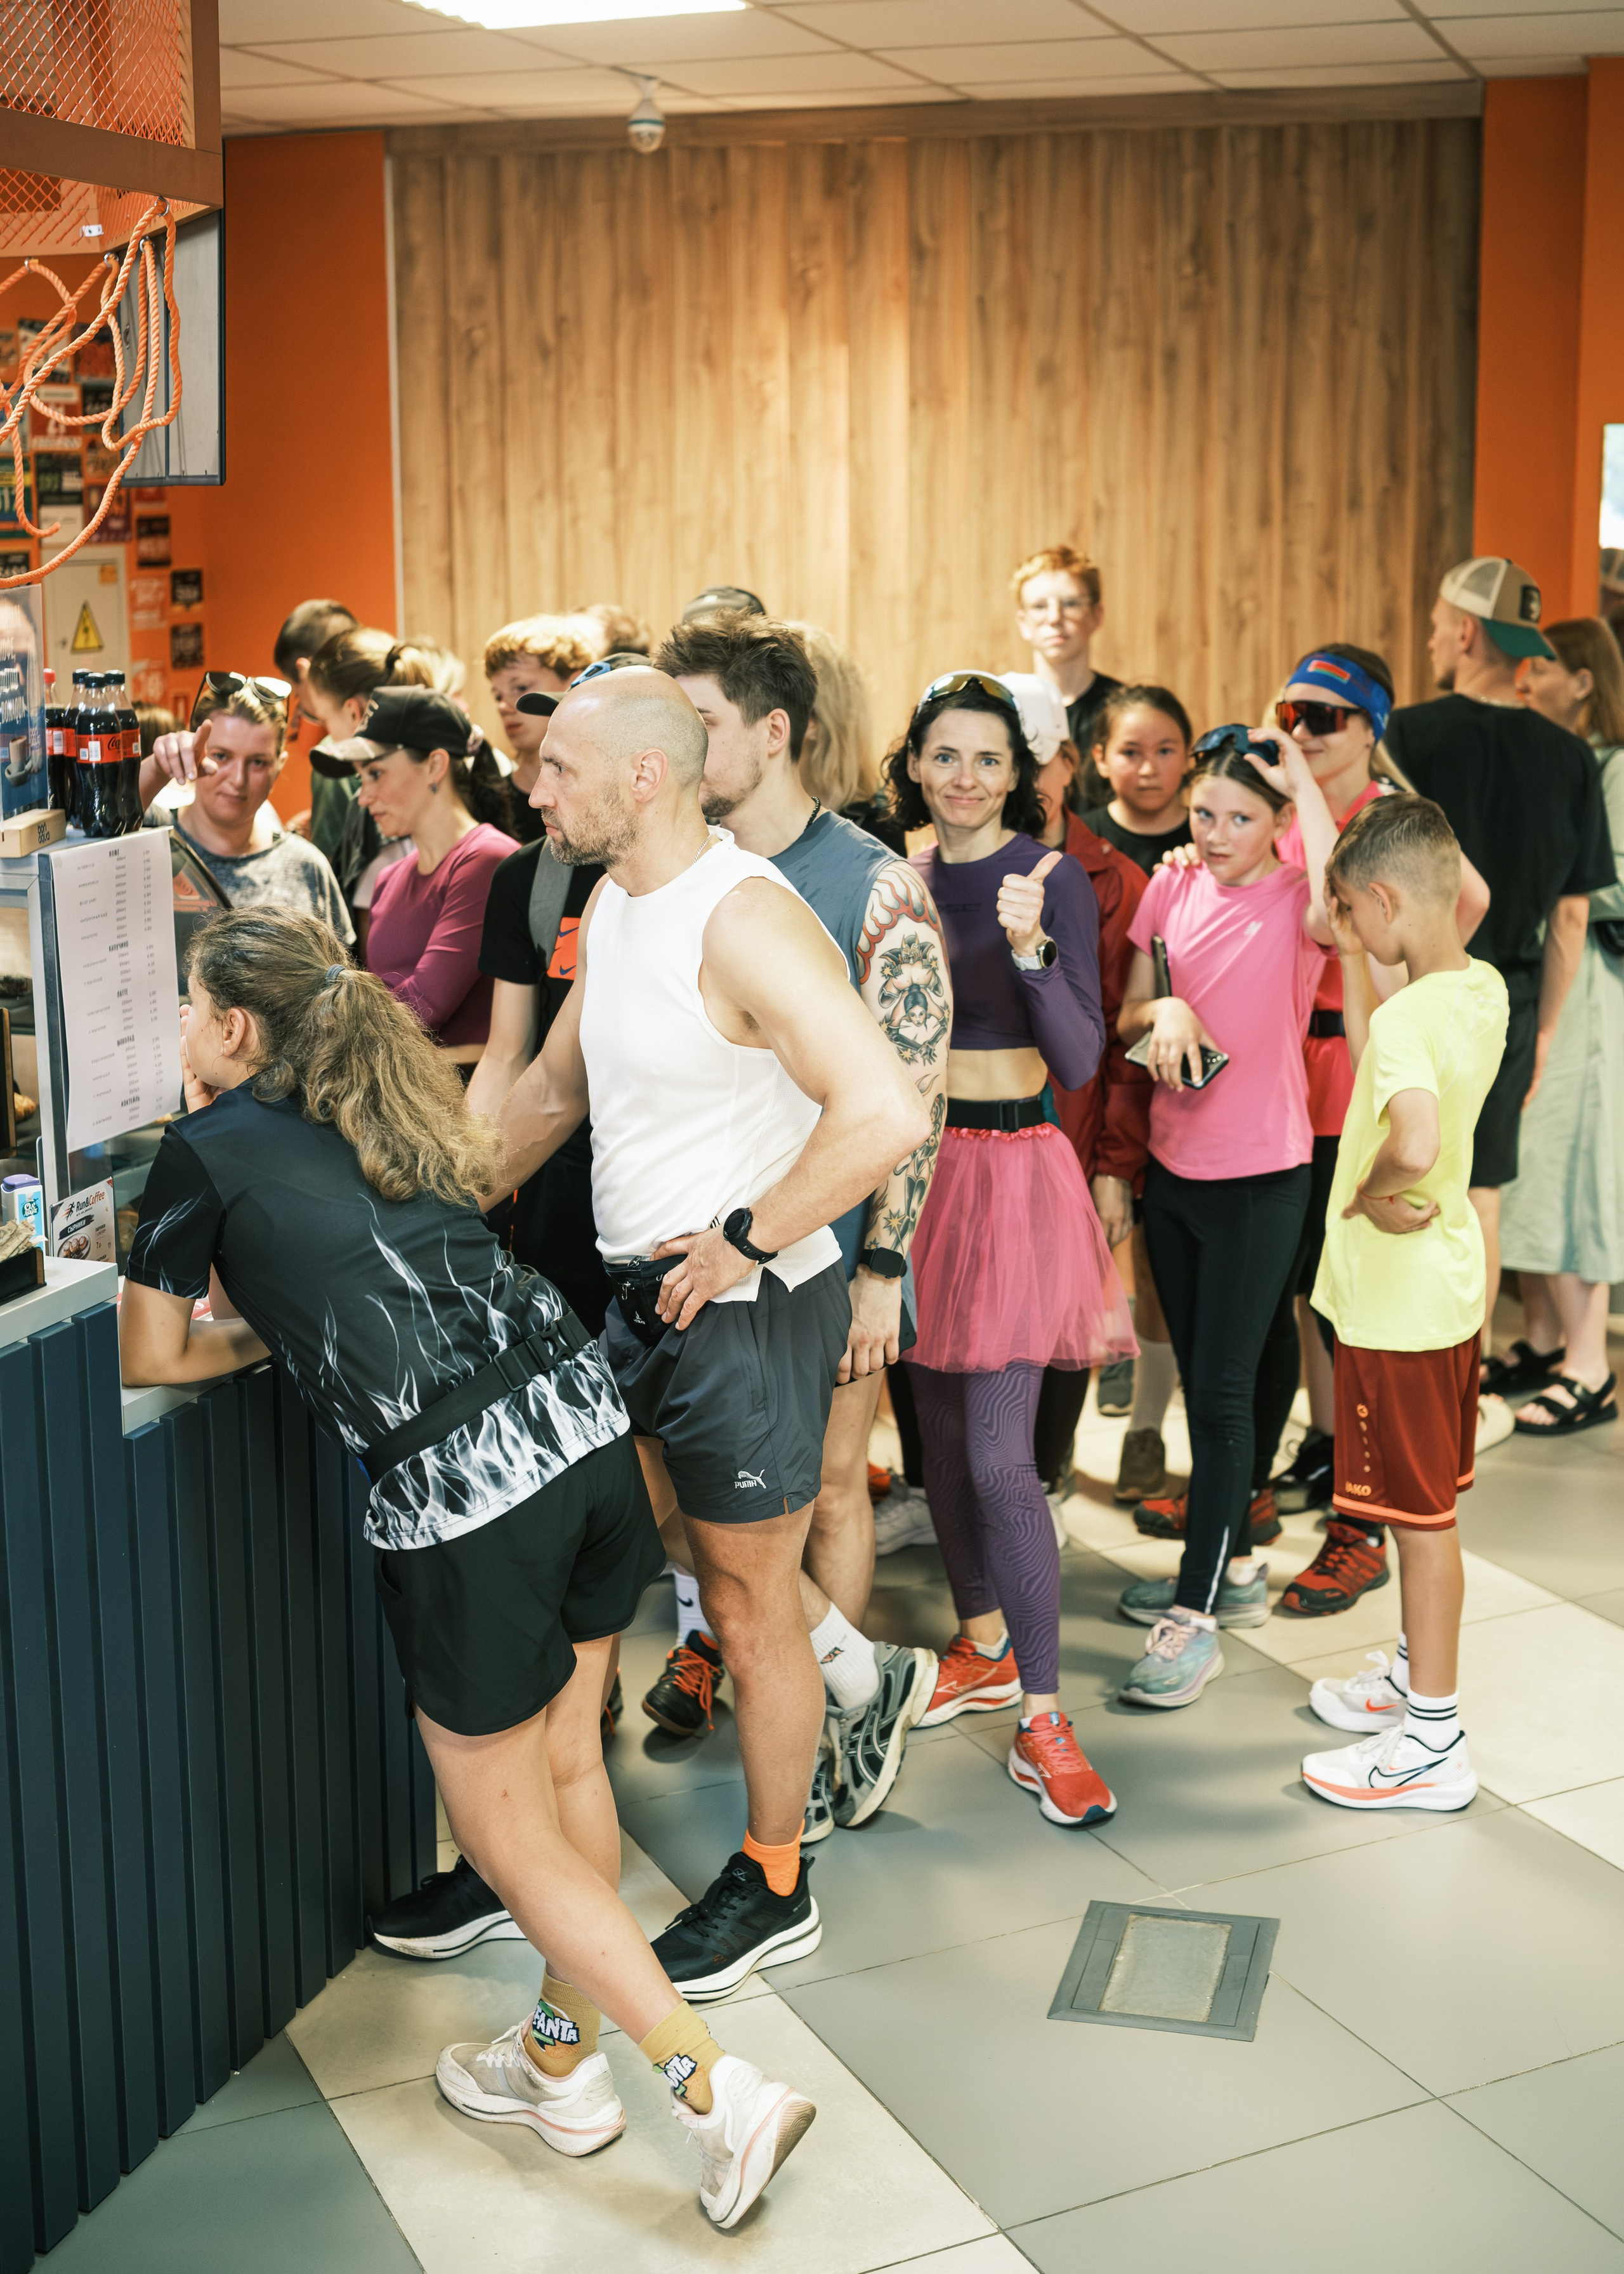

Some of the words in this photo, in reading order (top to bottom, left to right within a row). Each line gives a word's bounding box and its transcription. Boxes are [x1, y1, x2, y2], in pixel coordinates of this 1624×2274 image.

[117, 988, 128, 998] ЛАТТЕ
[117, 1034, 135, 1047] ШОКОЛАД
[121, 1095, 140, 1107] КОКТЕЙЛЬ
[76, 1192, 105, 1212] Run&Coffee
[67, 1219, 86, 1233] СЫРНИКИ
[734, 1479, 757, 1489] PUMA
[532, 2004, 579, 2042] FANTA
